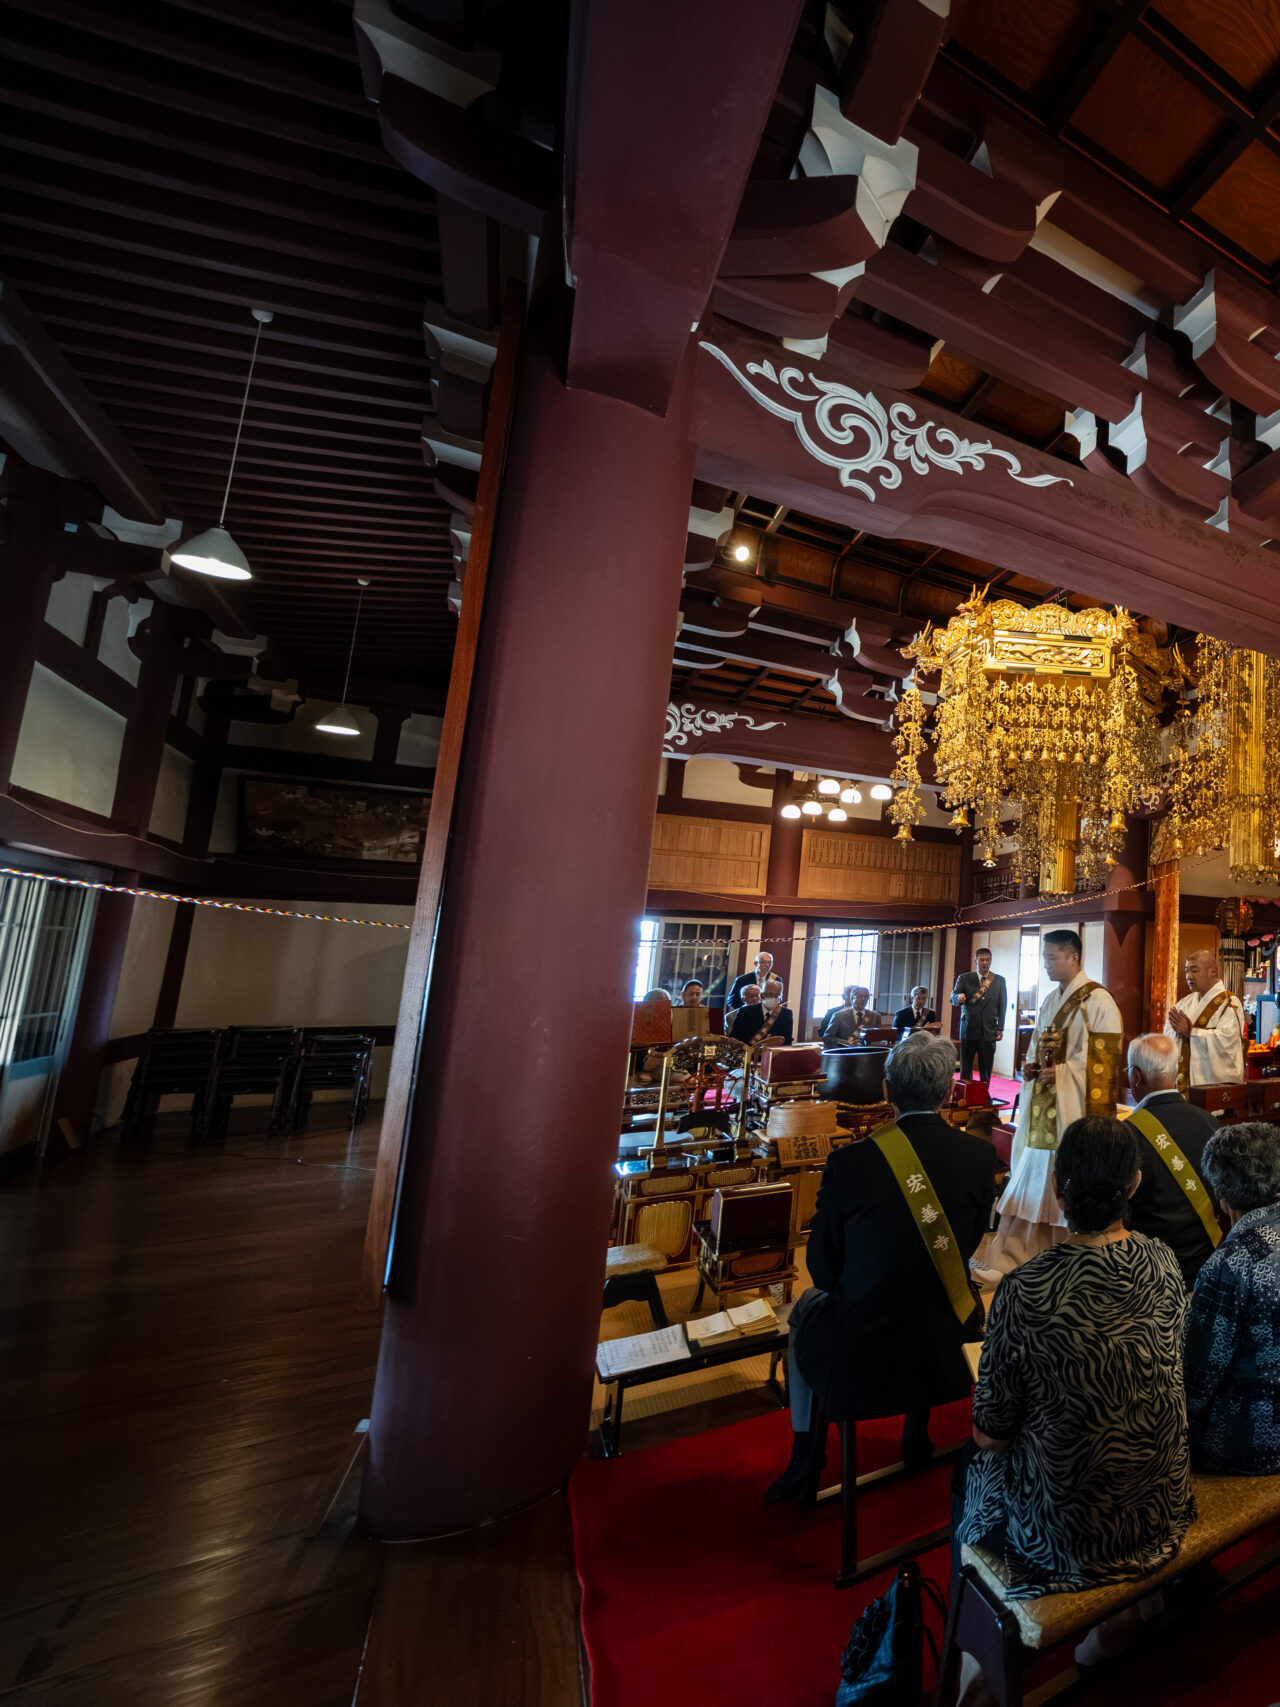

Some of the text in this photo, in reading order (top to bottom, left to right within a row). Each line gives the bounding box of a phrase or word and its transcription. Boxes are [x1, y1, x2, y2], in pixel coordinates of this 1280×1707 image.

[1155, 1133, 1197, 1191] 宏善寺
[905, 1173, 950, 1251] 宏善寺
